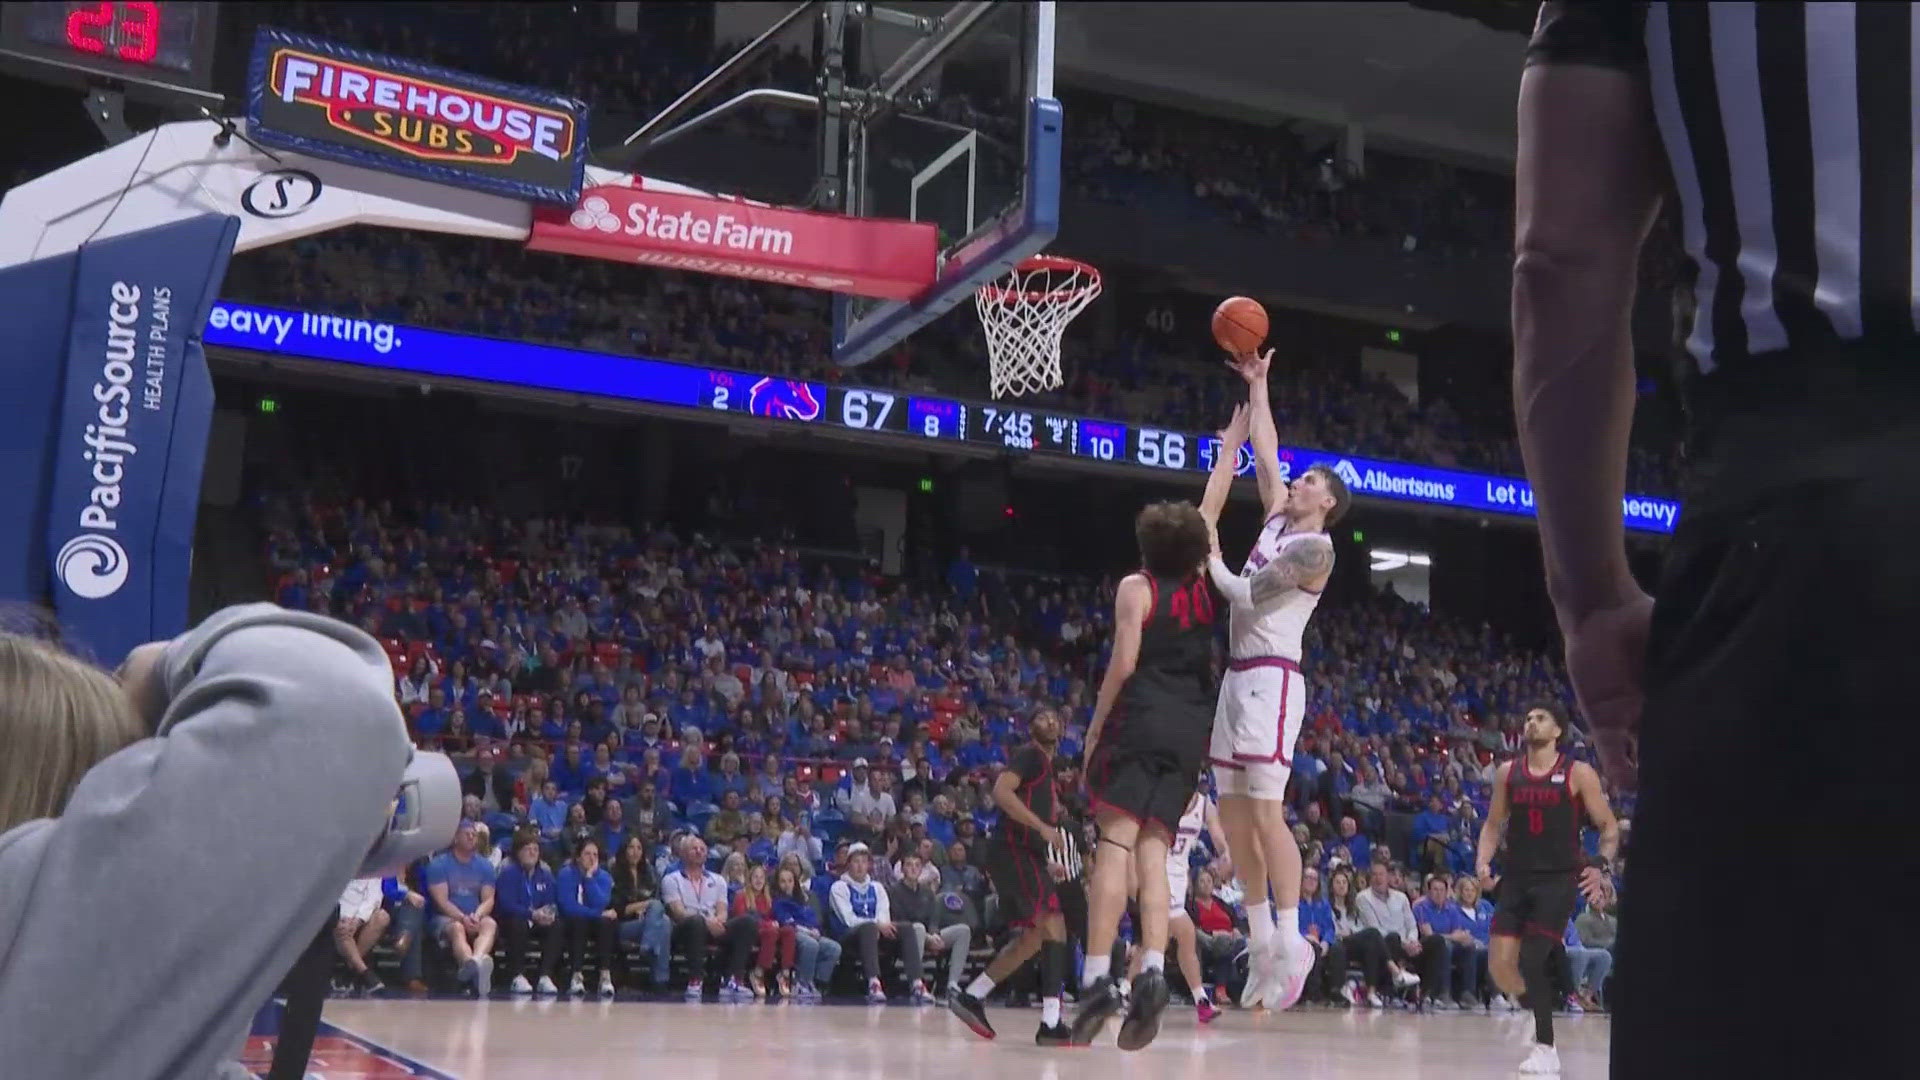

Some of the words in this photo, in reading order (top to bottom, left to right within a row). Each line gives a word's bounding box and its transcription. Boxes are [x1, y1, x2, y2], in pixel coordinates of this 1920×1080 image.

[66, 1, 159, 62] 23
[283, 57, 564, 161] FIREHOUSE
[373, 112, 474, 154] SUBS
[152, 286, 172, 340] PLANS
[143, 341, 166, 411] HEALTH
[80, 280, 142, 530] PacificSource
[713, 386, 729, 410] 2
[843, 390, 894, 430] 67
[924, 414, 940, 437] 8
[1090, 437, 1114, 461] 10
[1137, 429, 1185, 469] 56
[1363, 468, 1456, 501] Albertsons
[1487, 481, 1516, 505] Let
